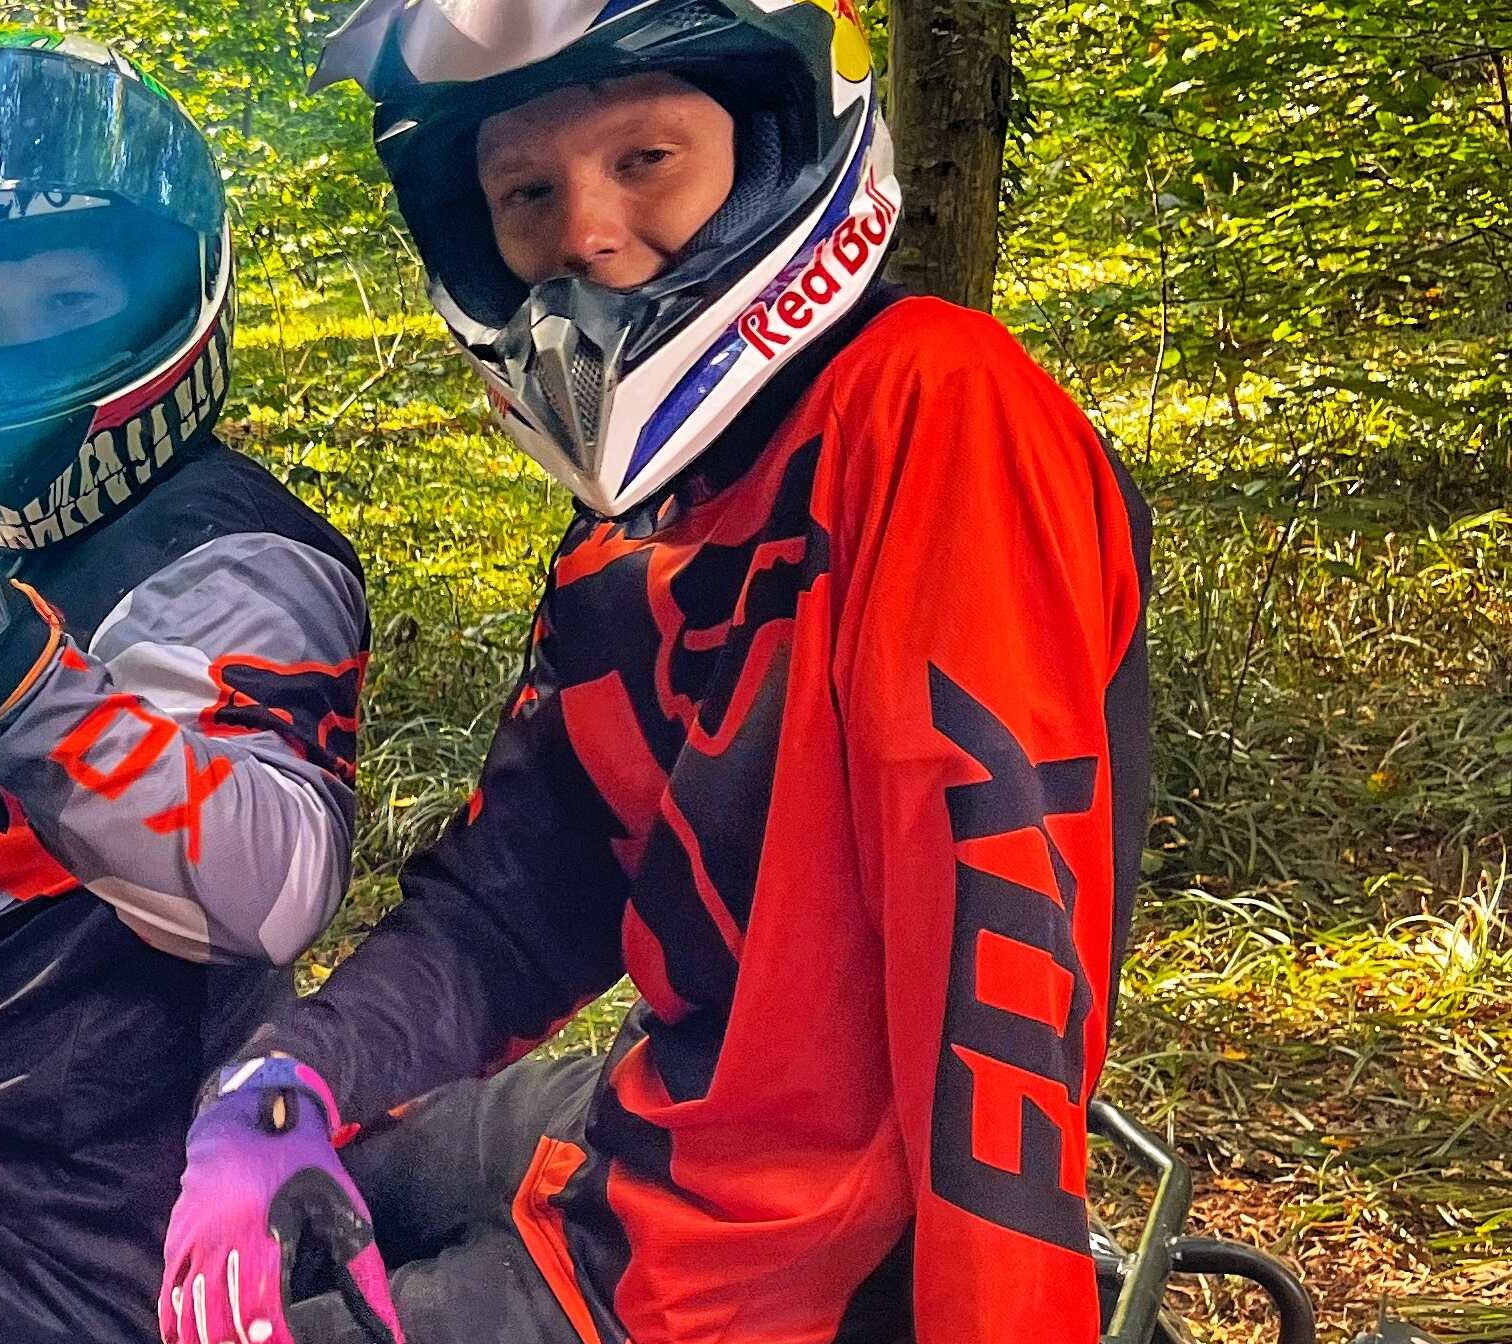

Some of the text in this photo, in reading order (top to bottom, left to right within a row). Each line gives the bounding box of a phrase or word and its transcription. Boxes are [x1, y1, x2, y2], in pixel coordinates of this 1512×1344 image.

[740, 164, 897, 360] Red Bull
[49, 646, 232, 866] OX
[926, 658, 1099, 1258] FOX
